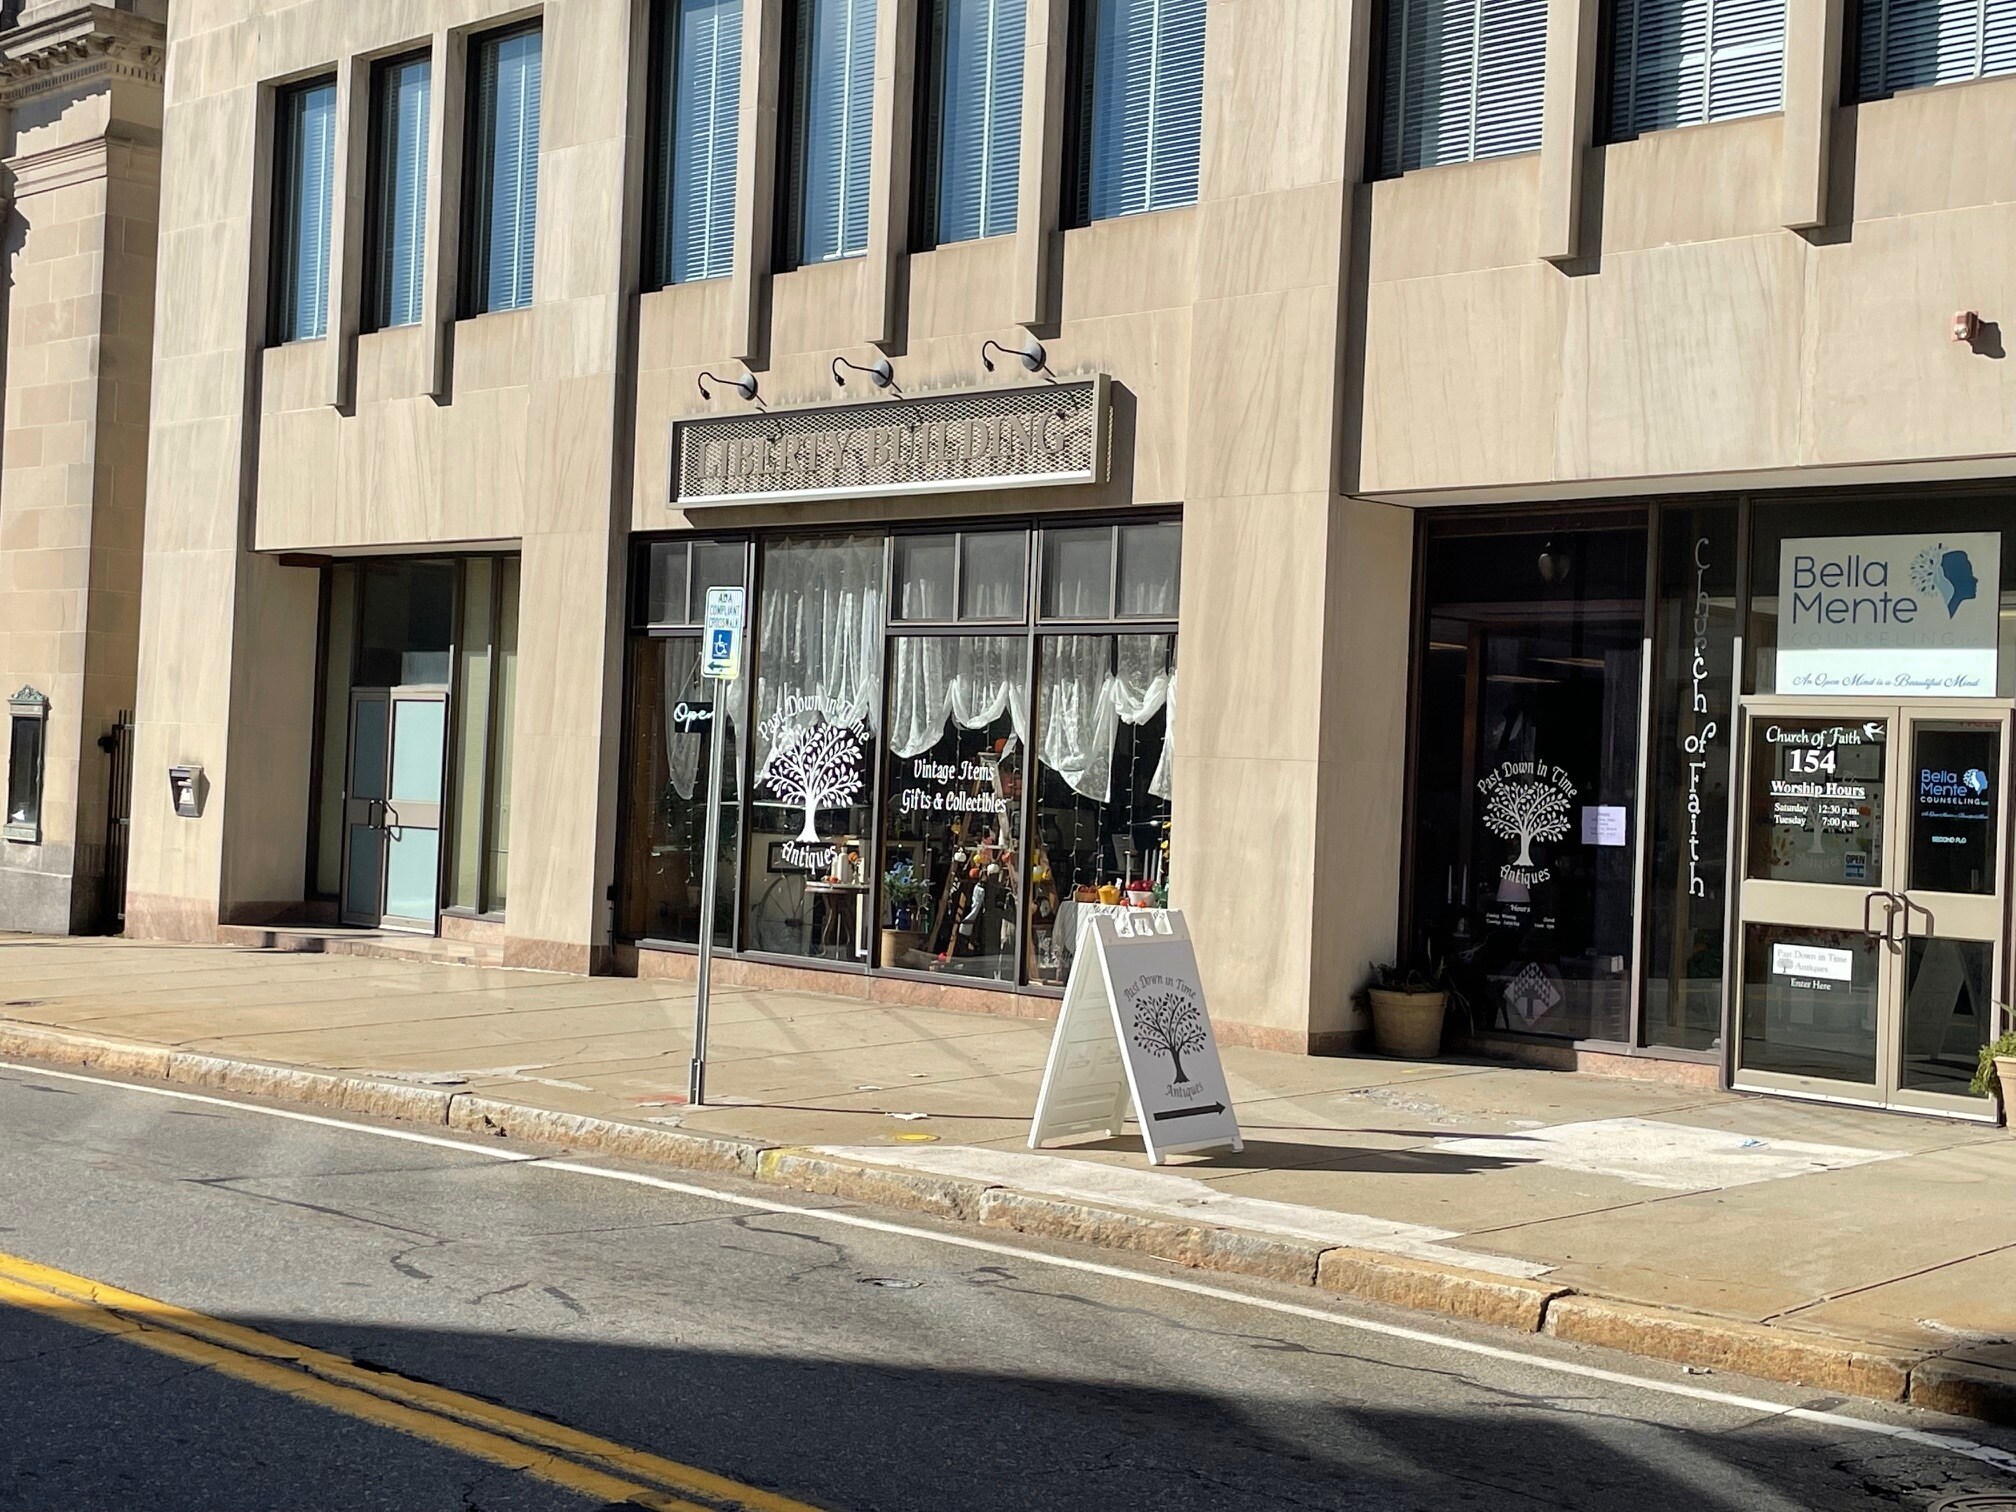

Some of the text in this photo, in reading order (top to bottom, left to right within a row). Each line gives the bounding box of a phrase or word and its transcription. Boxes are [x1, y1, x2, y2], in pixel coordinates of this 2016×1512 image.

[699, 411, 1066, 479] LIBERTY BUILDING
[1793, 554, 1888, 588] Bella
[718, 592, 733, 603] ADA
[709, 604, 740, 616] COMPLIANT
[1792, 591, 1918, 624] Mente
[1791, 631, 1955, 647] COUNSELING
[1793, 673, 1812, 686] An
[1815, 673, 1839, 687] Open
[1842, 673, 1876, 687] Mind
[1876, 678, 1884, 686] is
[1894, 673, 1941, 690] Beautiful
[1944, 674, 1980, 688] Mind
[759, 692, 870, 745] Past Down in Time
[1684, 537, 1717, 897] Church of Faith
[1766, 725, 1861, 749] Church of Faith
[1789, 749, 1836, 774] 154
[913, 758, 995, 785] Vintage Items
[1477, 759, 1577, 798] Past Down in Time
[1921, 769, 1957, 783] Bella
[1771, 780, 1865, 798] Worship Hours
[1920, 783, 1967, 796] Mente
[900, 788, 1007, 814] Gifts & Collectibles
[1774, 802, 1860, 816] Saturday 12:30 p.m.
[1920, 796, 1981, 806] COUNSELING
[1774, 815, 1860, 829] Tuesday 7:00 p.m.
[782, 840, 838, 875] Antiques
[1845, 854, 1866, 865] OPEN
[1500, 864, 1551, 889] Antiques
[1794, 949, 1817, 960] Down
[1828, 953, 1848, 963] Time
[1139, 974, 1163, 989] Down
[1165, 976, 1174, 987] in
[1176, 978, 1197, 999] Time
[1790, 977, 1832, 991] Enter Here
[1164, 1082, 1204, 1101] Antiques
